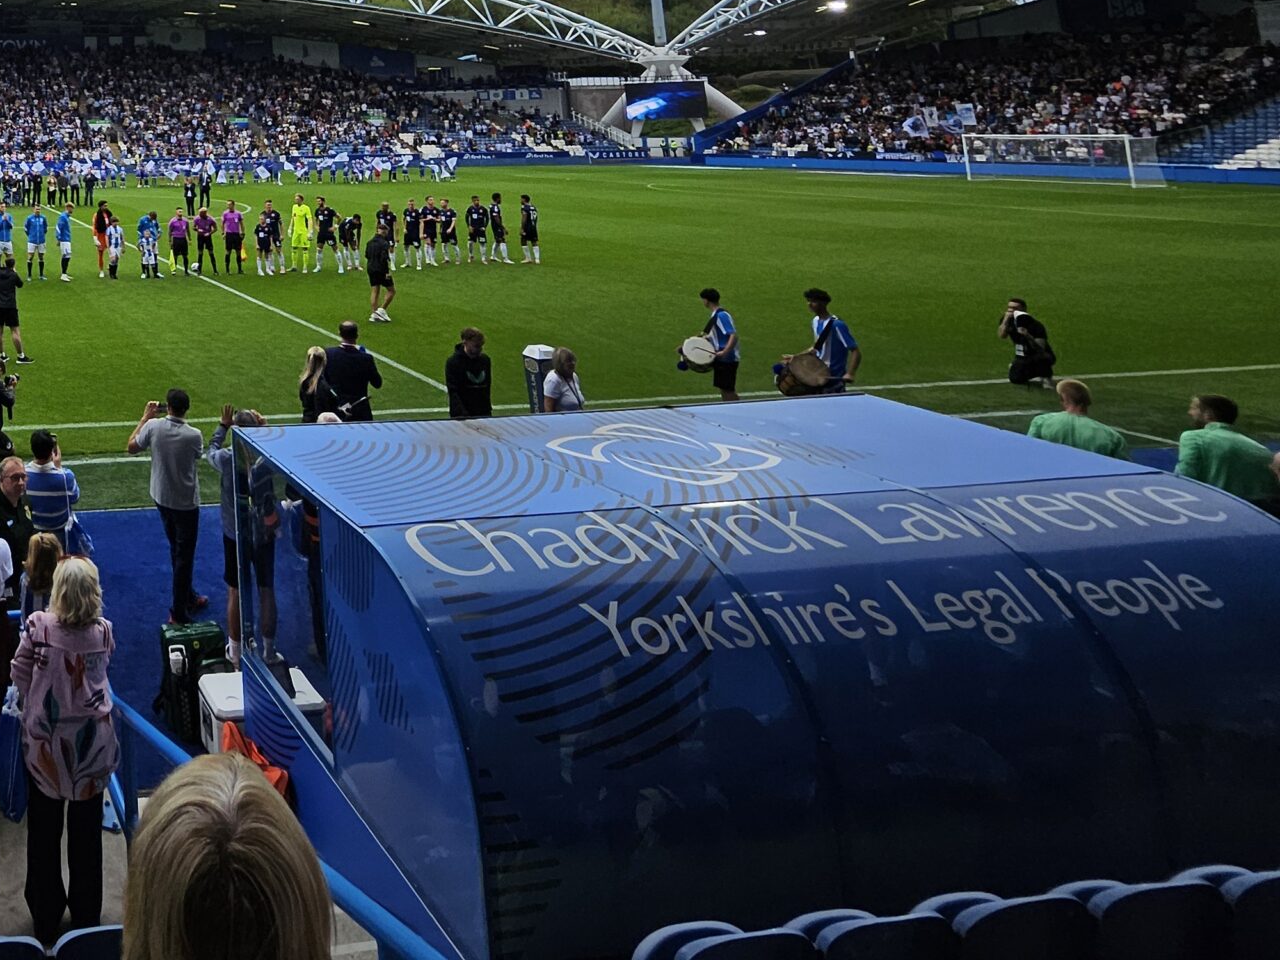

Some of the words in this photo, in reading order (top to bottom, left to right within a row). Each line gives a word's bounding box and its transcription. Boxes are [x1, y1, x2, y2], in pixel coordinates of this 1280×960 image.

[404, 500, 848, 577] Chadwick
[807, 486, 1228, 545] Lawrence
[886, 570, 1045, 644] Legal
[1026, 559, 1225, 632] People
